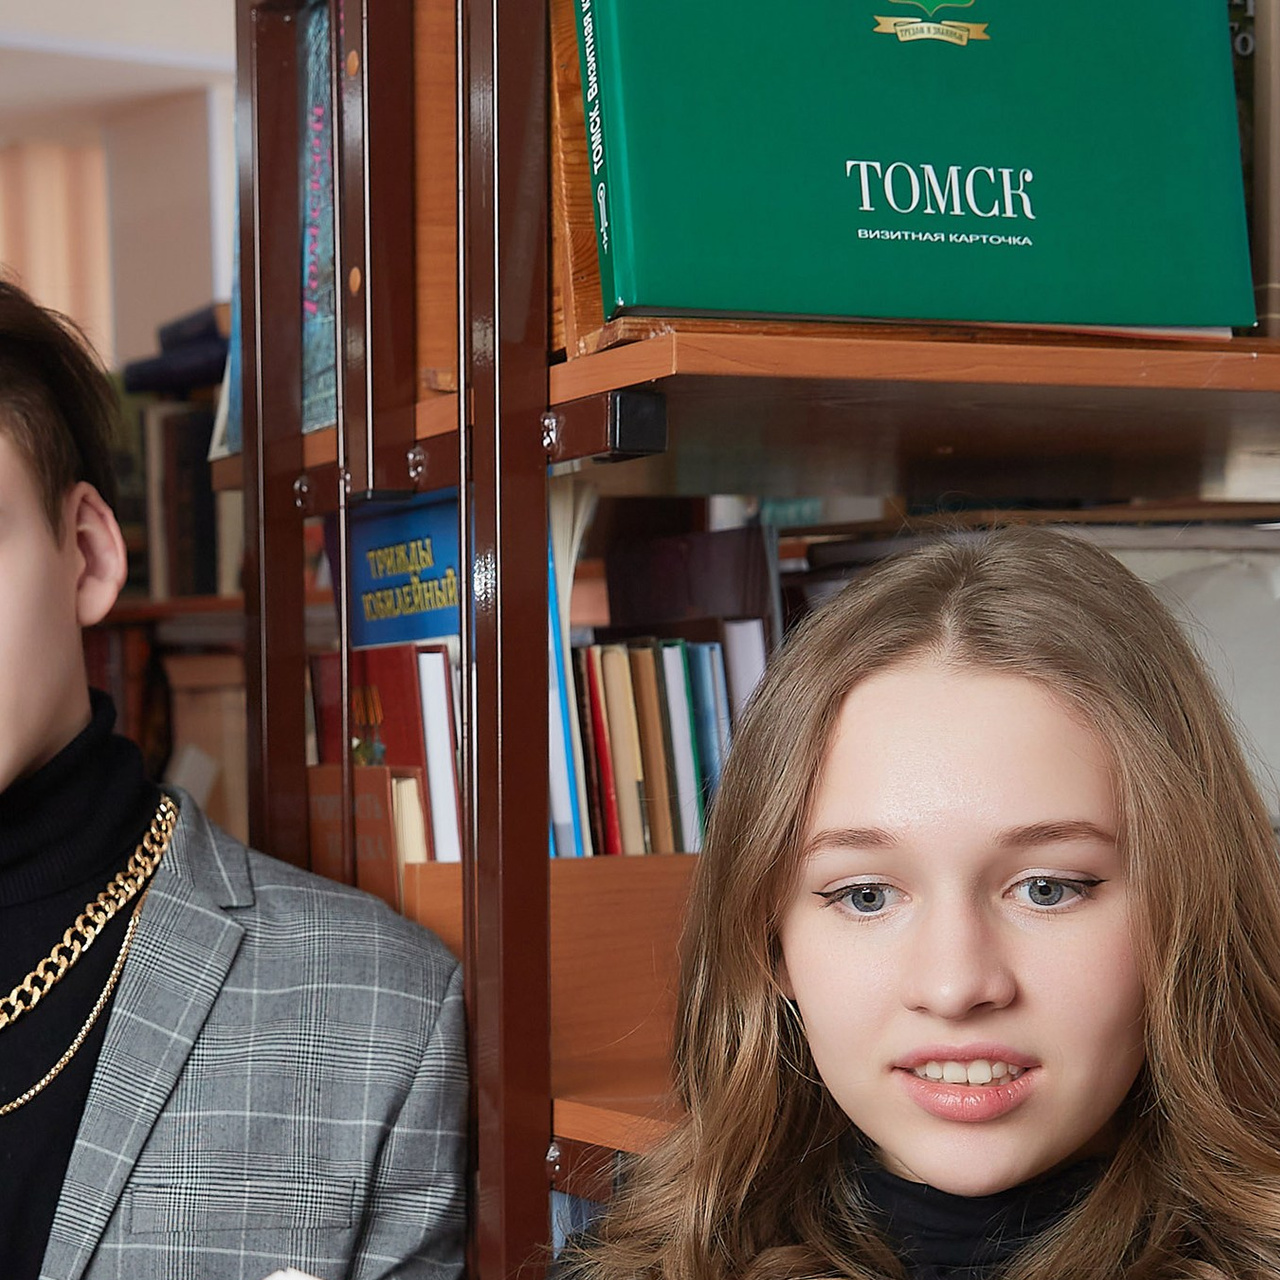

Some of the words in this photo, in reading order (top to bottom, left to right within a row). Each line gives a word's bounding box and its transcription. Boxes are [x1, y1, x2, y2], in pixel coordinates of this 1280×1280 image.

[582, 11, 599, 102] Визитная
[588, 100, 604, 176] ТОМСК.
[845, 160, 1037, 220] ТОМСК
[857, 228, 946, 243] ВИЗИТНАЯ
[948, 232, 1033, 247] КАРТОЧКА
[366, 537, 435, 579] ТРИЖДЫ
[361, 567, 460, 622] ЮБИЛЕЙНЫЙ
